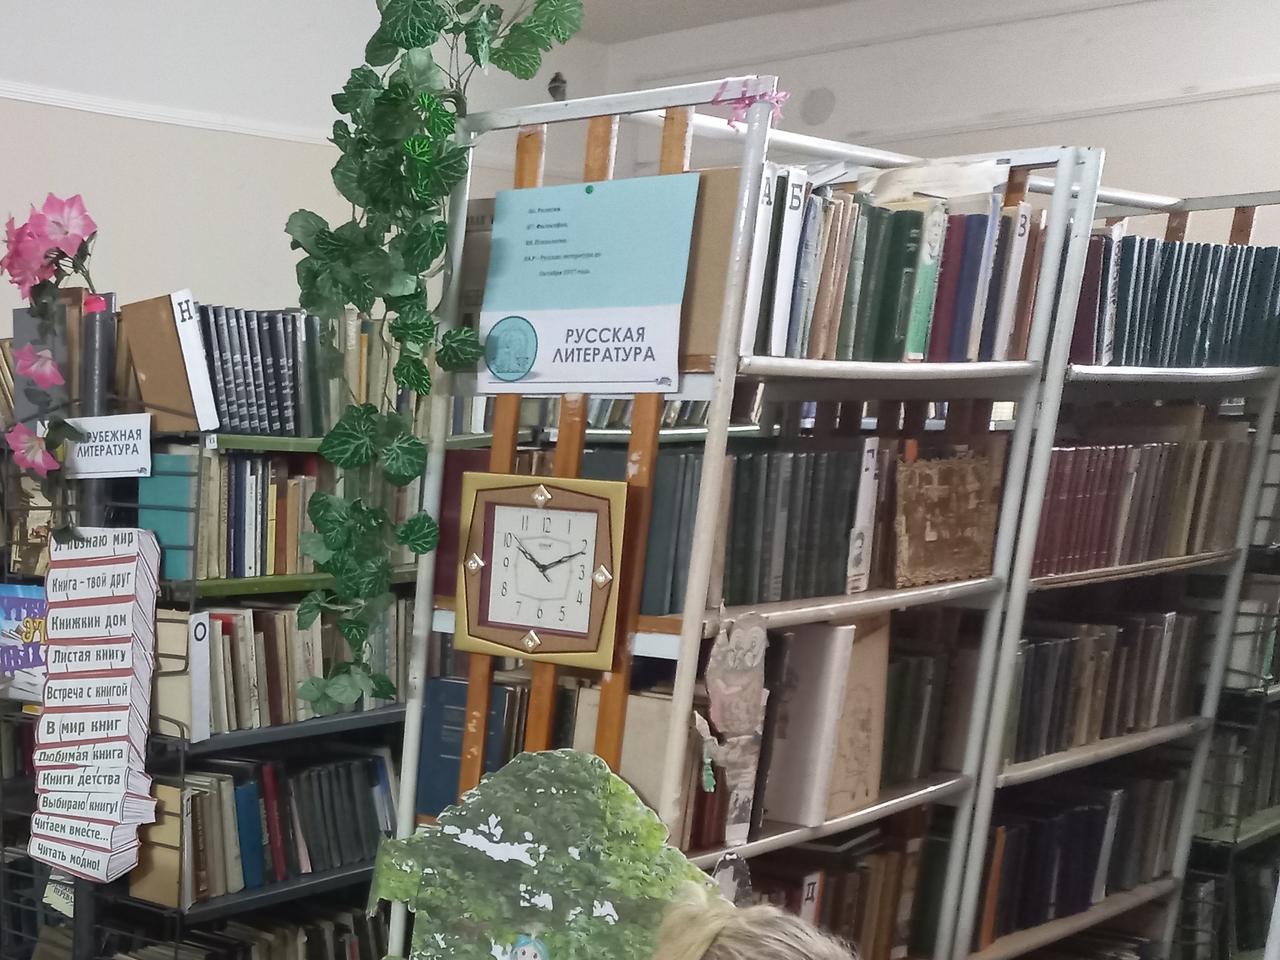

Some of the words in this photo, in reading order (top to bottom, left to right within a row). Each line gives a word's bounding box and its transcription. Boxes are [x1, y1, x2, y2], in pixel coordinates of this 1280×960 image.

[788, 183, 803, 211] Б
[177, 299, 194, 323] Н
[565, 326, 646, 344] РУССКАЯ
[552, 346, 656, 363] ЛИТЕРАТУРА
[77, 428, 142, 444] РУБЕЖНАЯ
[76, 443, 140, 458] ЛИТЕРАТУРА
[521, 515, 529, 531] 11
[542, 517, 552, 533] 12
[113, 530, 134, 548] мир
[503, 532, 512, 548] 10
[578, 565, 585, 580] 3
[52, 576, 79, 592] Книга
[86, 573, 108, 588] твой
[110, 571, 132, 589] друг
[501, 581, 508, 597] 8
[576, 590, 583, 606] 4
[536, 603, 543, 619] 6
[558, 606, 565, 622] 5
[51, 615, 105, 631] Книжкин
[107, 613, 127, 630] дом
[193, 621, 207, 643] О
[52, 649, 93, 665] Листая
[95, 647, 126, 663] книгу
[47, 683, 84, 703] Встреча
[86, 687, 92, 698] с
[95, 681, 128, 699] книгой
[46, 720, 56, 735] В
[60, 720, 86, 736] мир
[90, 717, 122, 733] книг
[39, 751, 89, 763] Любимая
[92, 747, 123, 762] книга
[42, 772, 74, 786] Книги
[77, 771, 121, 787] детства
[42, 795, 86, 811] Выбираю
[88, 798, 119, 814] книгу!
[34, 816, 66, 834] Читаем
[69, 824, 109, 842] вместе...
[37, 841, 67, 862] Читать
[70, 851, 100, 872] модно!
